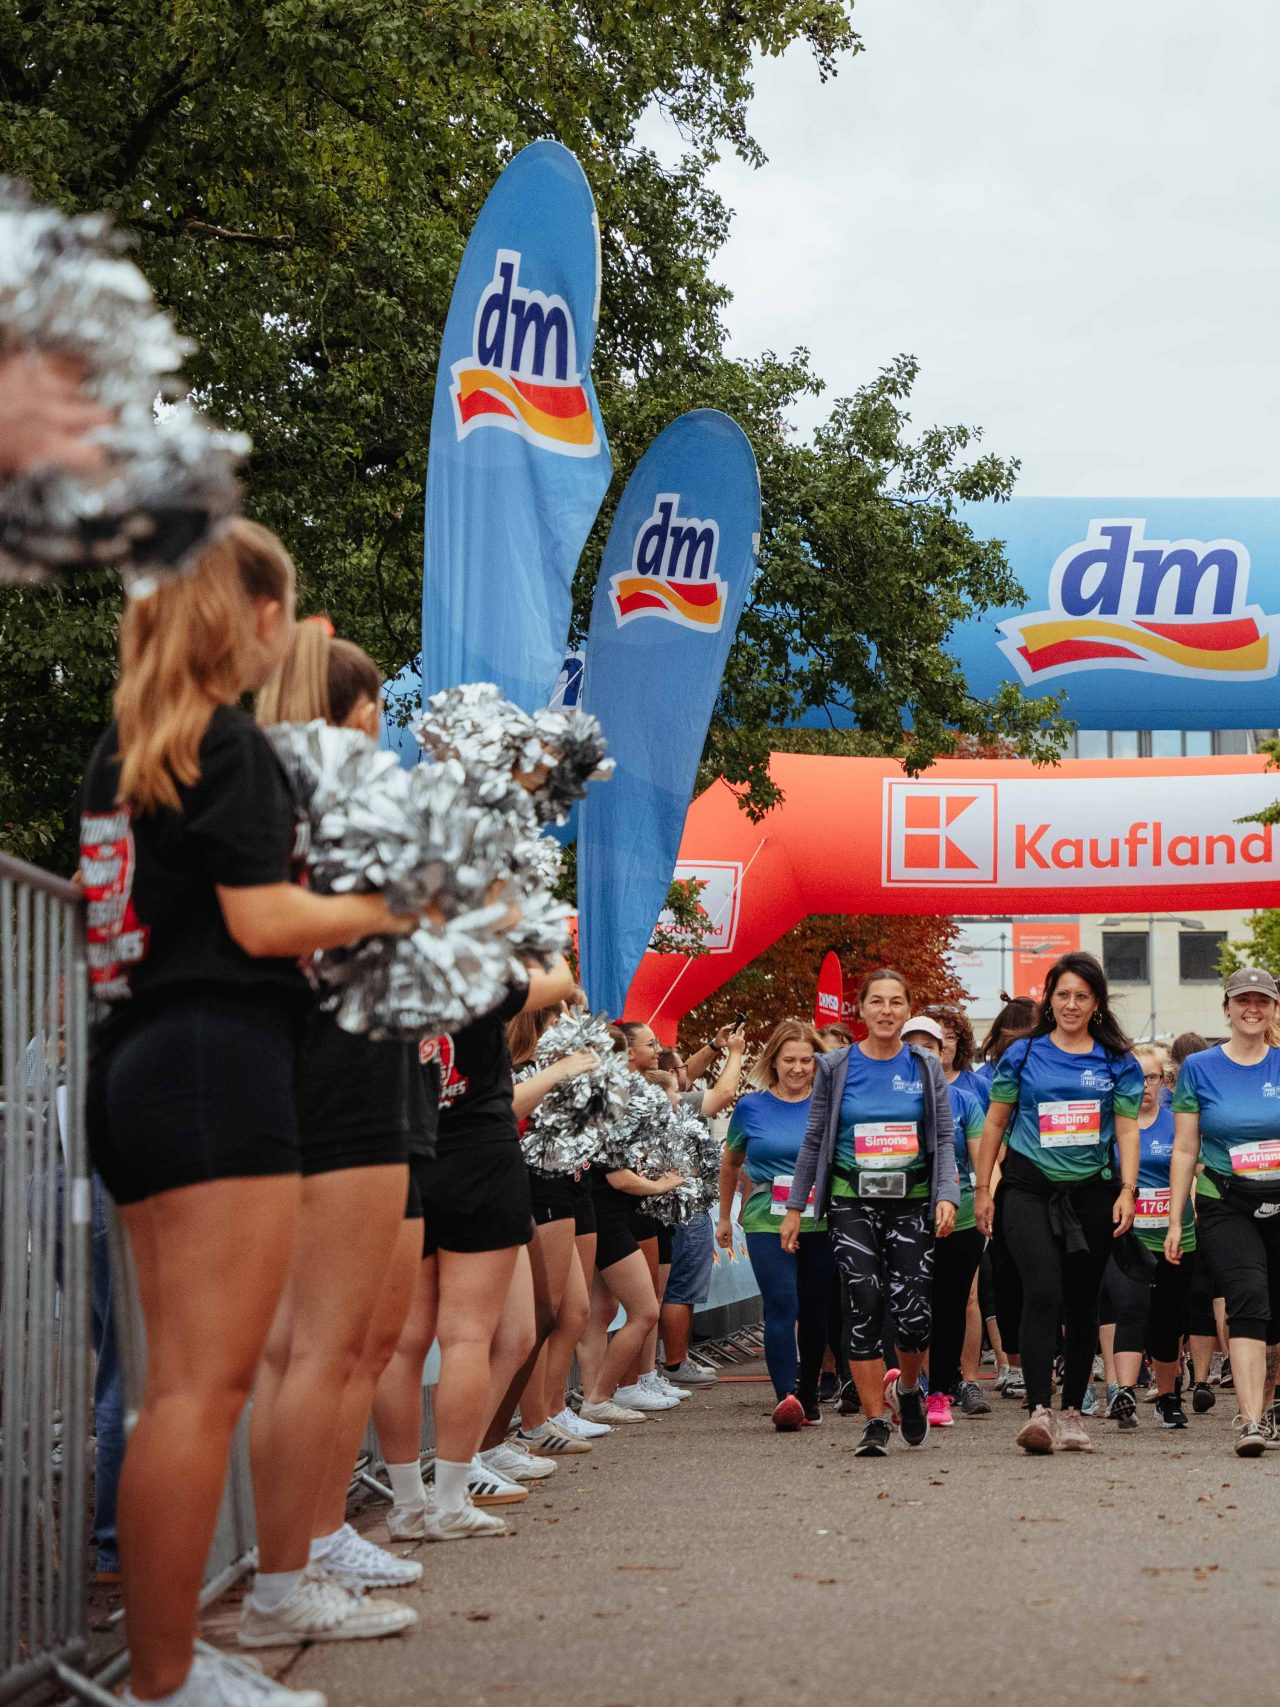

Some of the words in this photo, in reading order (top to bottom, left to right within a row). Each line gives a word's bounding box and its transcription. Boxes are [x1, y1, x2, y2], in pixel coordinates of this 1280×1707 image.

[477, 262, 569, 381] dm
[637, 500, 715, 580] dm
[1060, 525, 1239, 617] dm
[1014, 821, 1273, 870] Kaufland
[865, 1135, 908, 1147] Simone
[1051, 1114, 1090, 1125] Sabine
[1141, 1201, 1170, 1213] 1764
